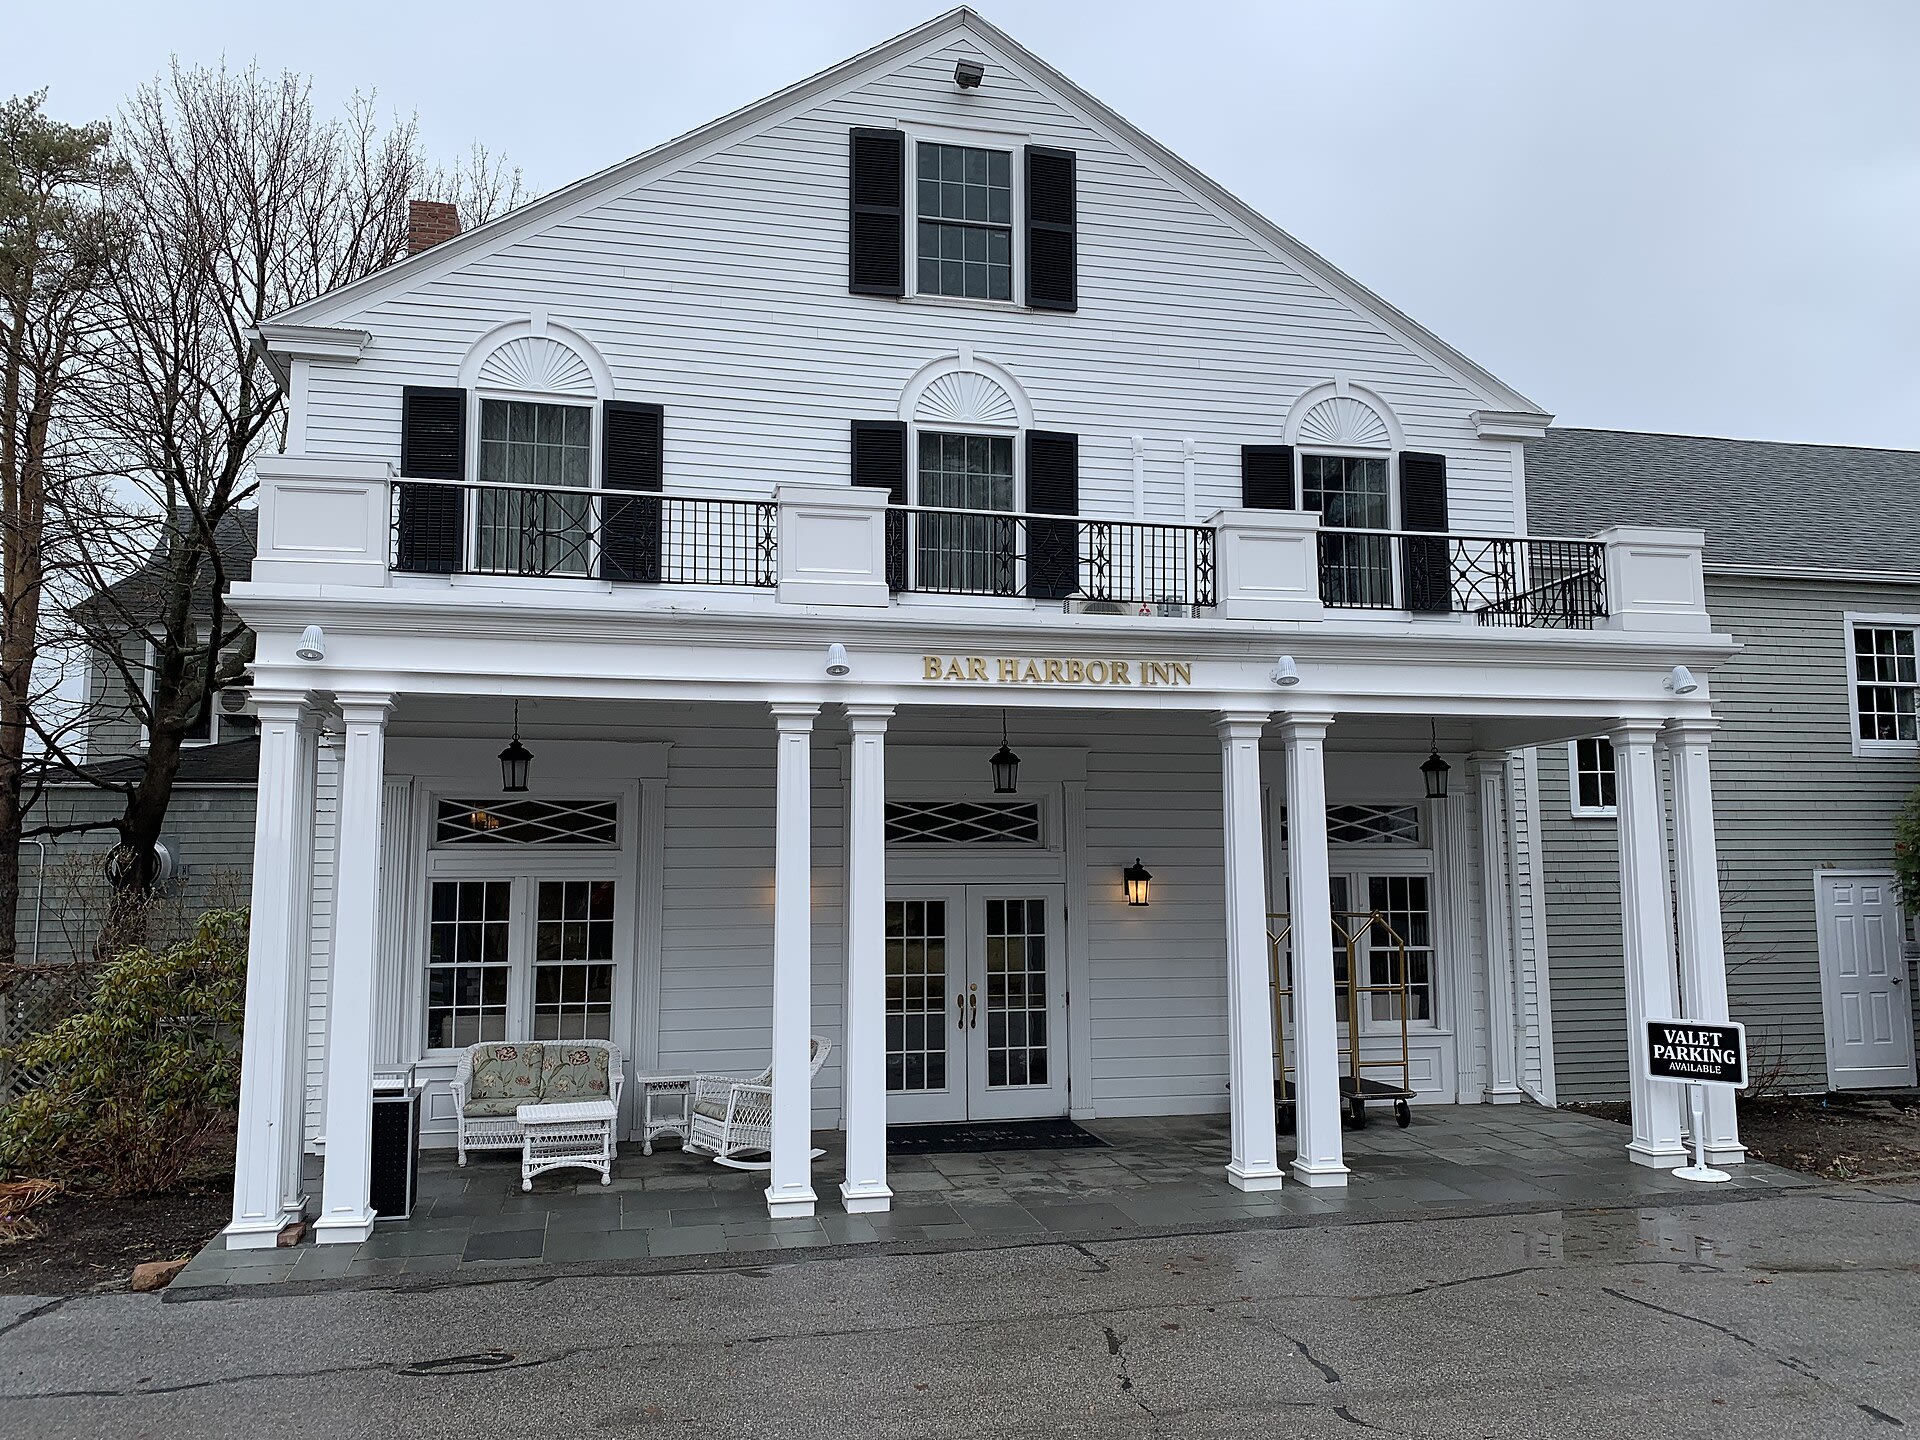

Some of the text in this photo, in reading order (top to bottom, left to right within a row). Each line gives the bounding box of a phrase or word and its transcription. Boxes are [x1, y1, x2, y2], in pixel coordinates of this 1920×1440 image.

[922, 655, 1193, 685] BAR HARBOR INN
[1663, 1029, 1722, 1047] VALET
[1653, 1044, 1736, 1065] PARKING
[1669, 1062, 1721, 1074] AVAILABLE
